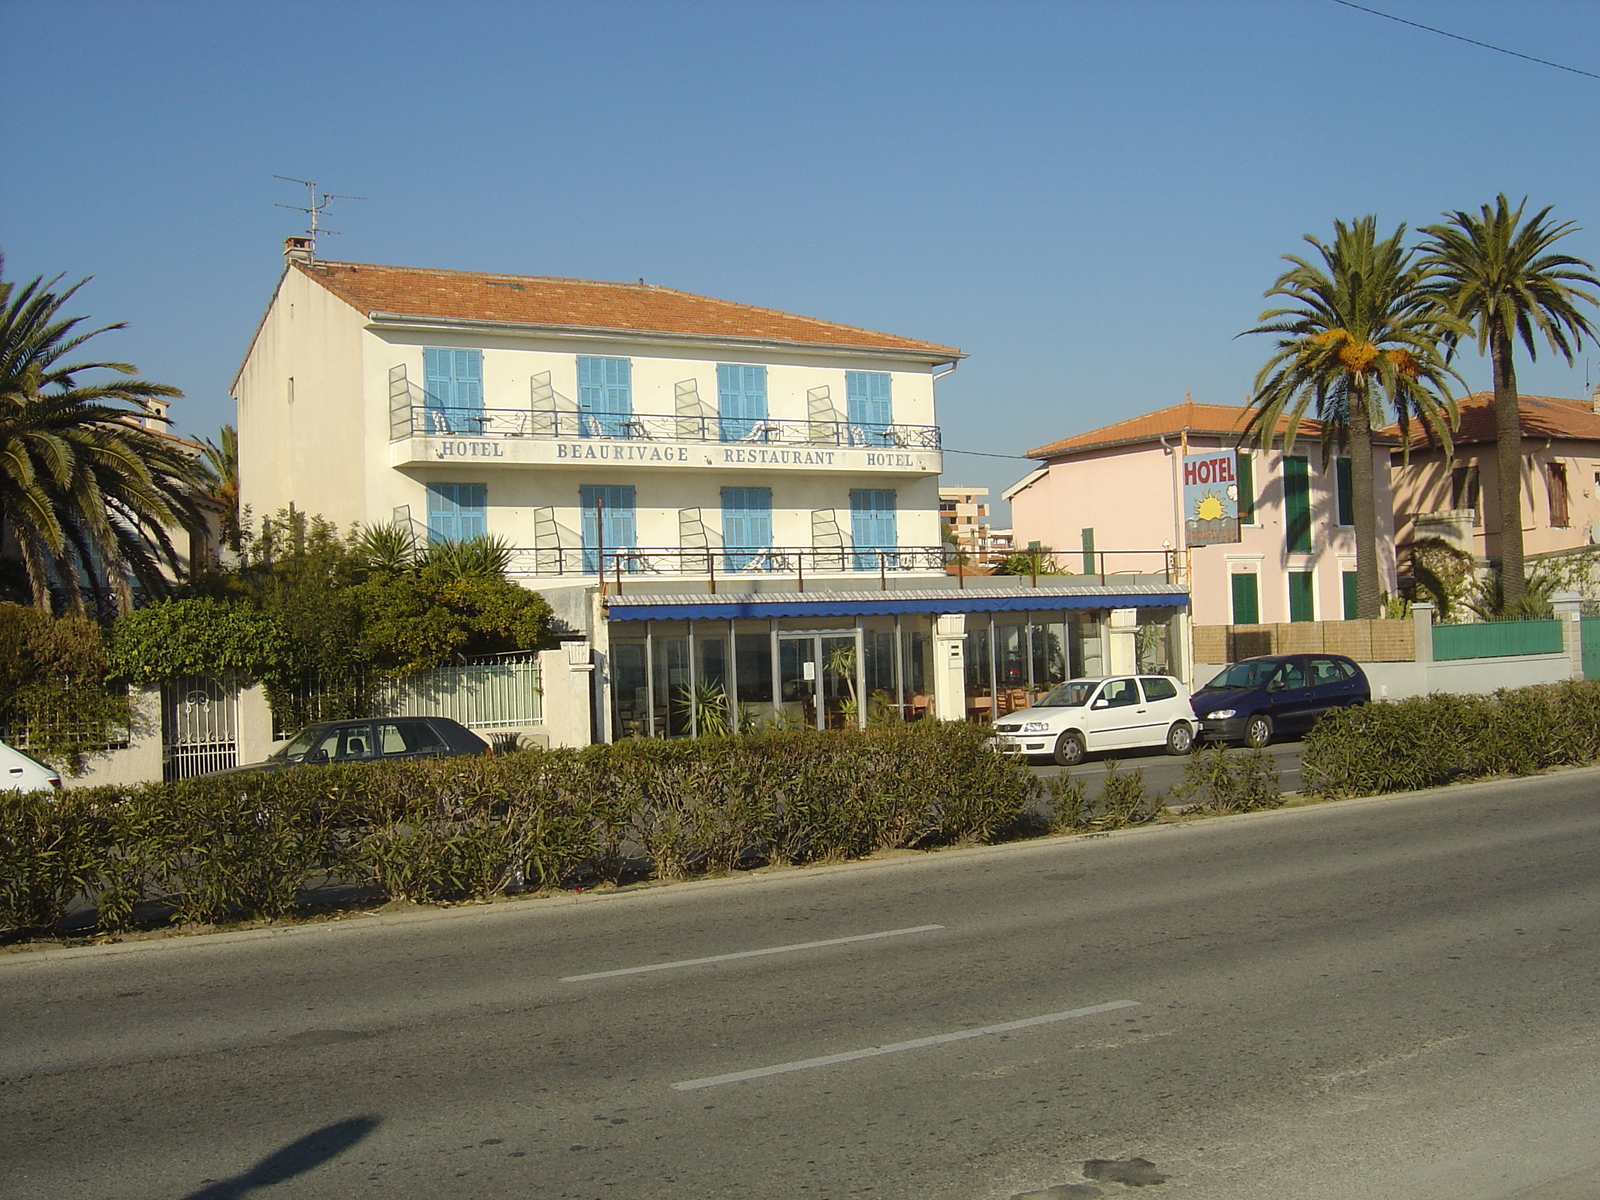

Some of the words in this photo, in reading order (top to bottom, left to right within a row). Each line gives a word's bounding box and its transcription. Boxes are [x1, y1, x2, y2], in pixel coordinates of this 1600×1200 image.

[442, 441, 503, 457] HOTEL
[557, 443, 688, 461] BEAURIVAGE
[724, 448, 834, 465] RESTAURANT
[867, 453, 913, 467] HOTEL
[1184, 457, 1235, 486] HOTEL
